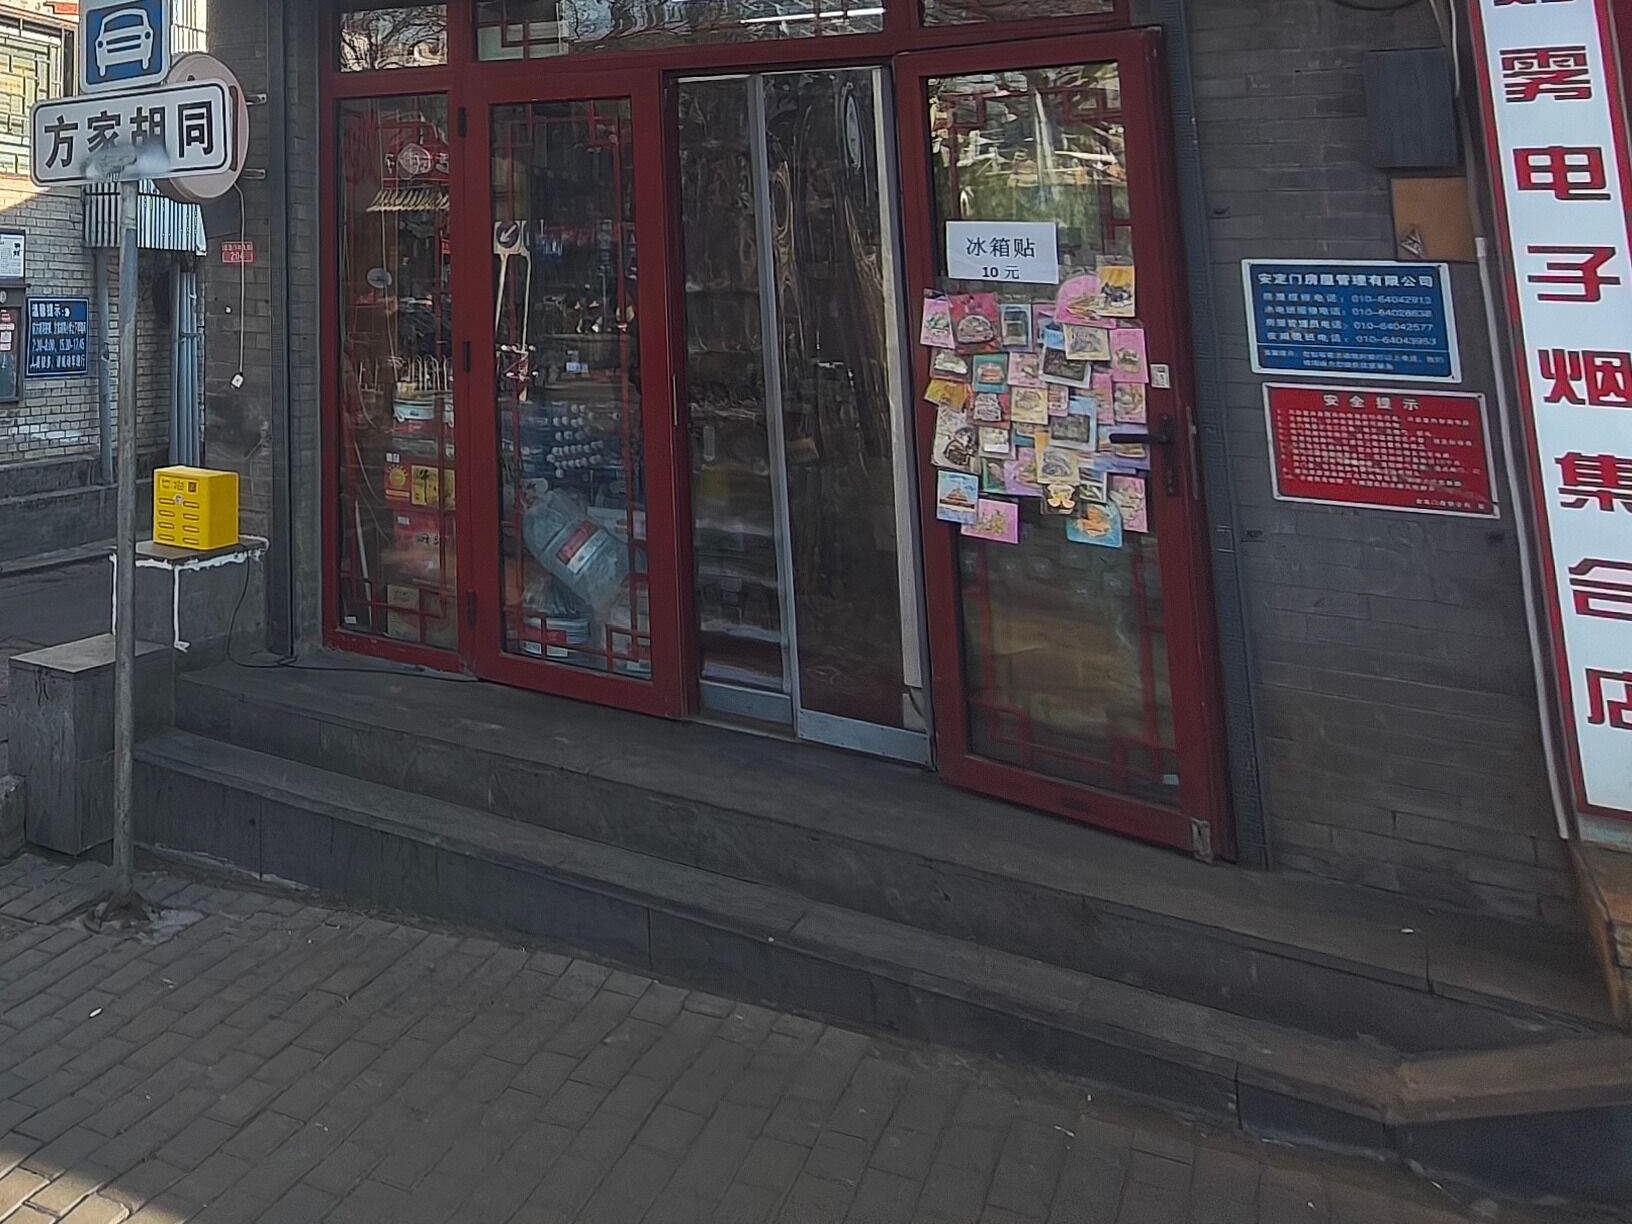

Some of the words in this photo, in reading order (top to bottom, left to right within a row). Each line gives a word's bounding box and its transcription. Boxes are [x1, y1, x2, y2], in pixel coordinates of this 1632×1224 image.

[44, 100, 215, 169] 方家胡同
[966, 236, 1036, 258] 冰箱贴
[981, 266, 999, 278] 10
[1005, 266, 1020, 279] 元
[1257, 273, 1434, 287] 安定门房屋管理有限公司
[1323, 394, 1420, 411] 安全提示
